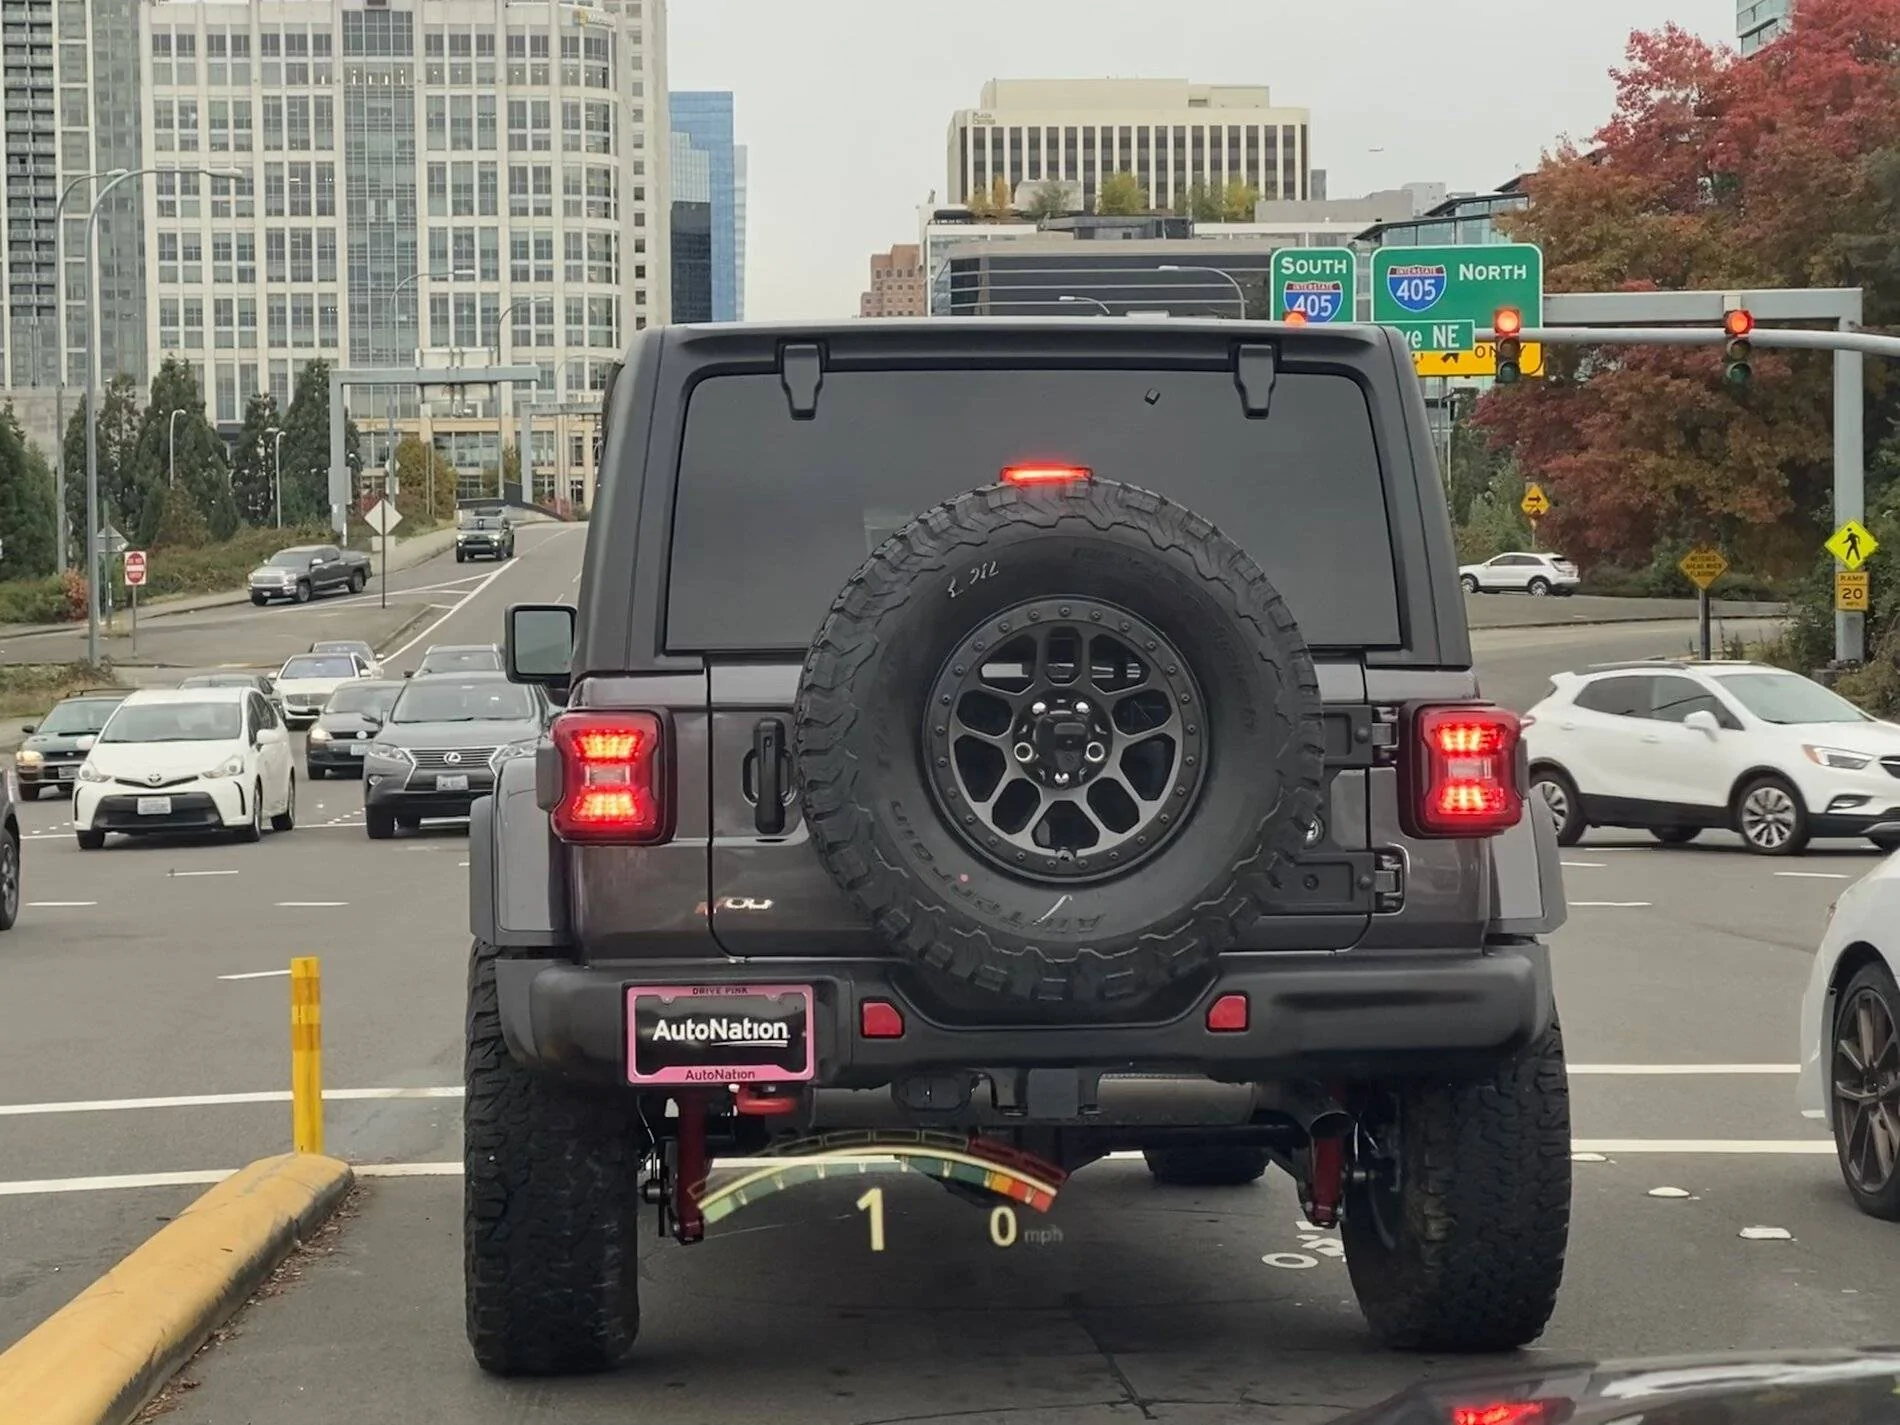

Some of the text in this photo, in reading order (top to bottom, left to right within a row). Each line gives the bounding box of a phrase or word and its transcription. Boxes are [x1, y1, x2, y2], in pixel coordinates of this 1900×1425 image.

[1280, 256, 1347, 275] SOUTH
[1395, 265, 1438, 275] INTERSTATE
[1458, 263, 1527, 281] NORTH
[1292, 283, 1333, 291] INTERSTATE
[1396, 279, 1436, 301] 405
[1292, 294, 1333, 317] 405
[1432, 324, 1460, 348] NE
[1842, 587, 1863, 600] 20
[692, 987, 722, 995] DRIVE
[652, 1018, 790, 1042] AutoNation
[685, 1069, 756, 1081] AutoNation
[856, 1187, 885, 1252] 1
[989, 1205, 1064, 1248] 0 mph
